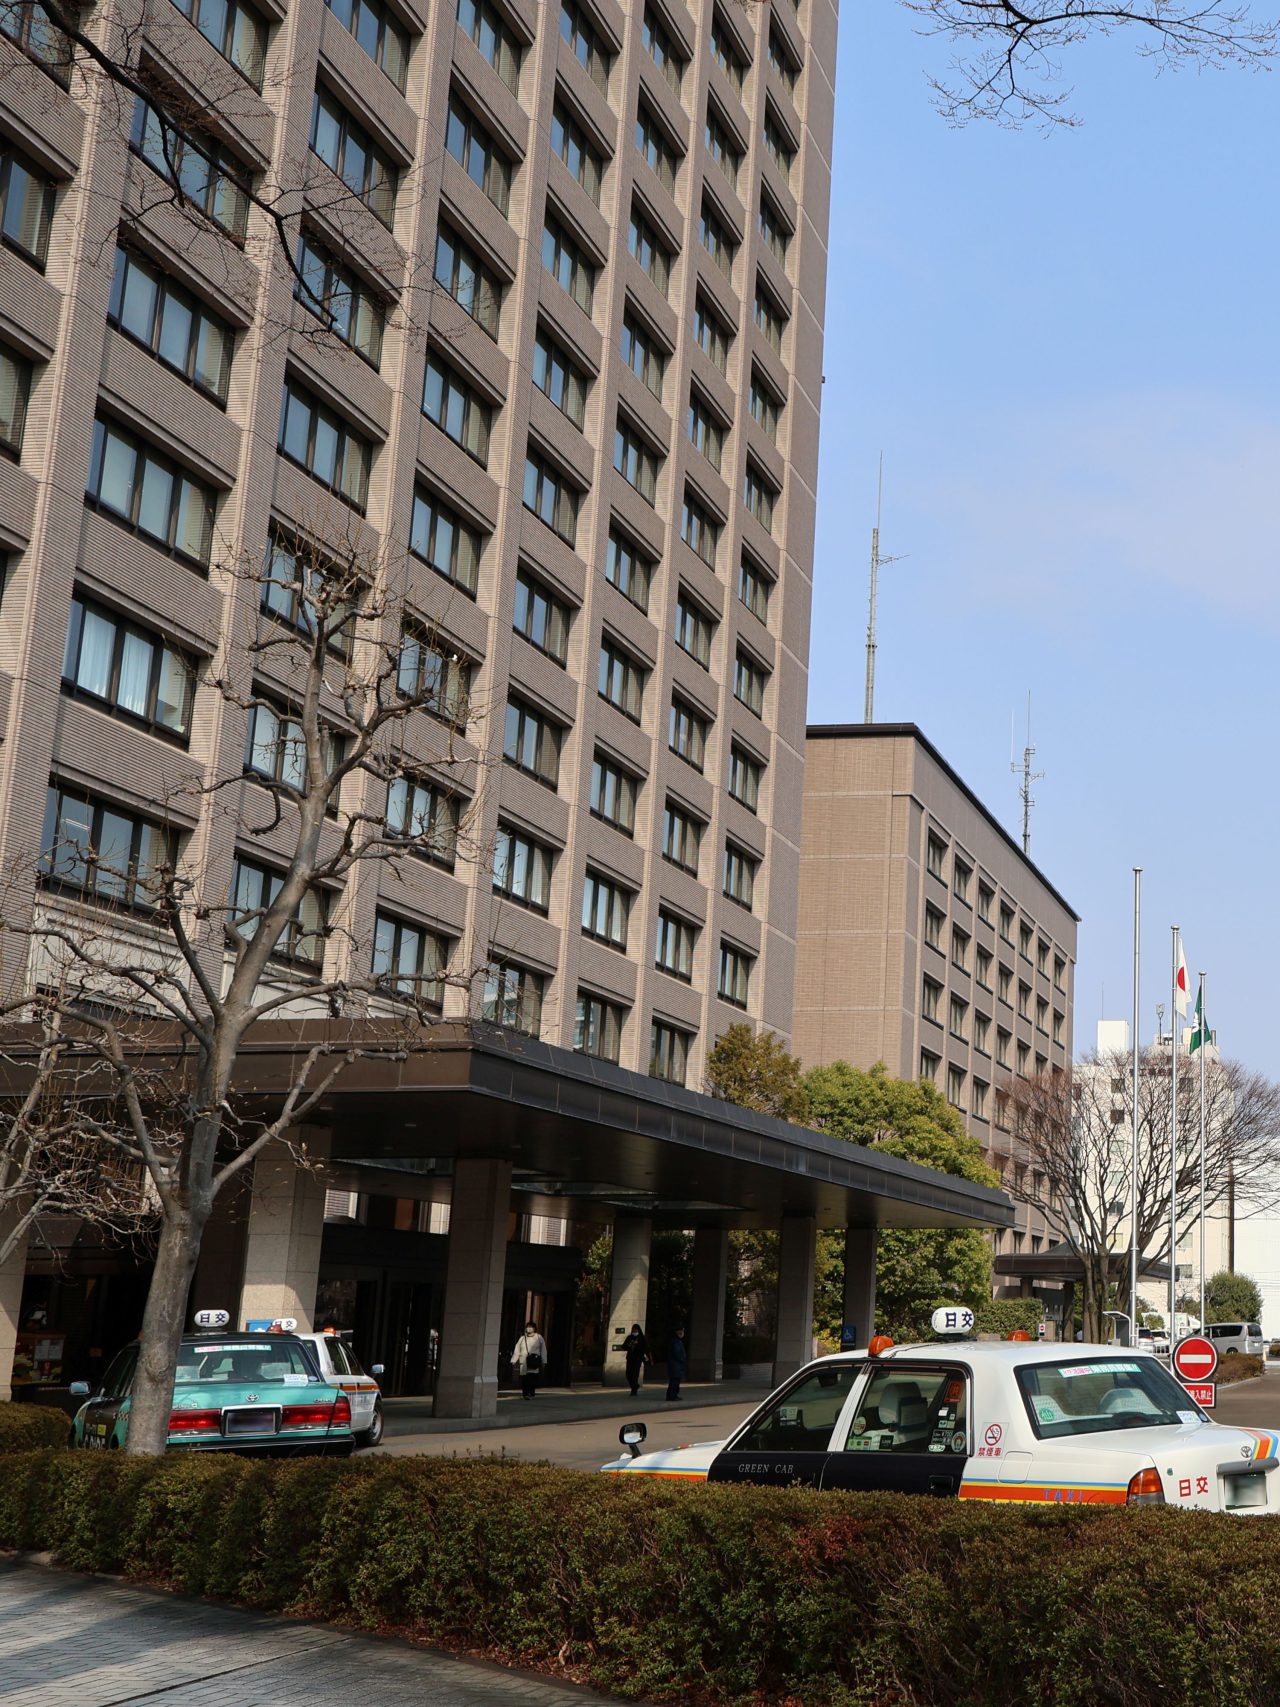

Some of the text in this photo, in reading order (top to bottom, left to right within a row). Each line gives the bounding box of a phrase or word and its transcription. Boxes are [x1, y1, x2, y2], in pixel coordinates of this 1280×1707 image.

[200, 1312, 226, 1323] 日交
[945, 1310, 973, 1329] 日交
[977, 1447, 1002, 1457] 禁煙車
[738, 1463, 794, 1474] GREEN CAB
[1178, 1476, 1209, 1497] 日交
[1043, 1488, 1084, 1502] TAXI
